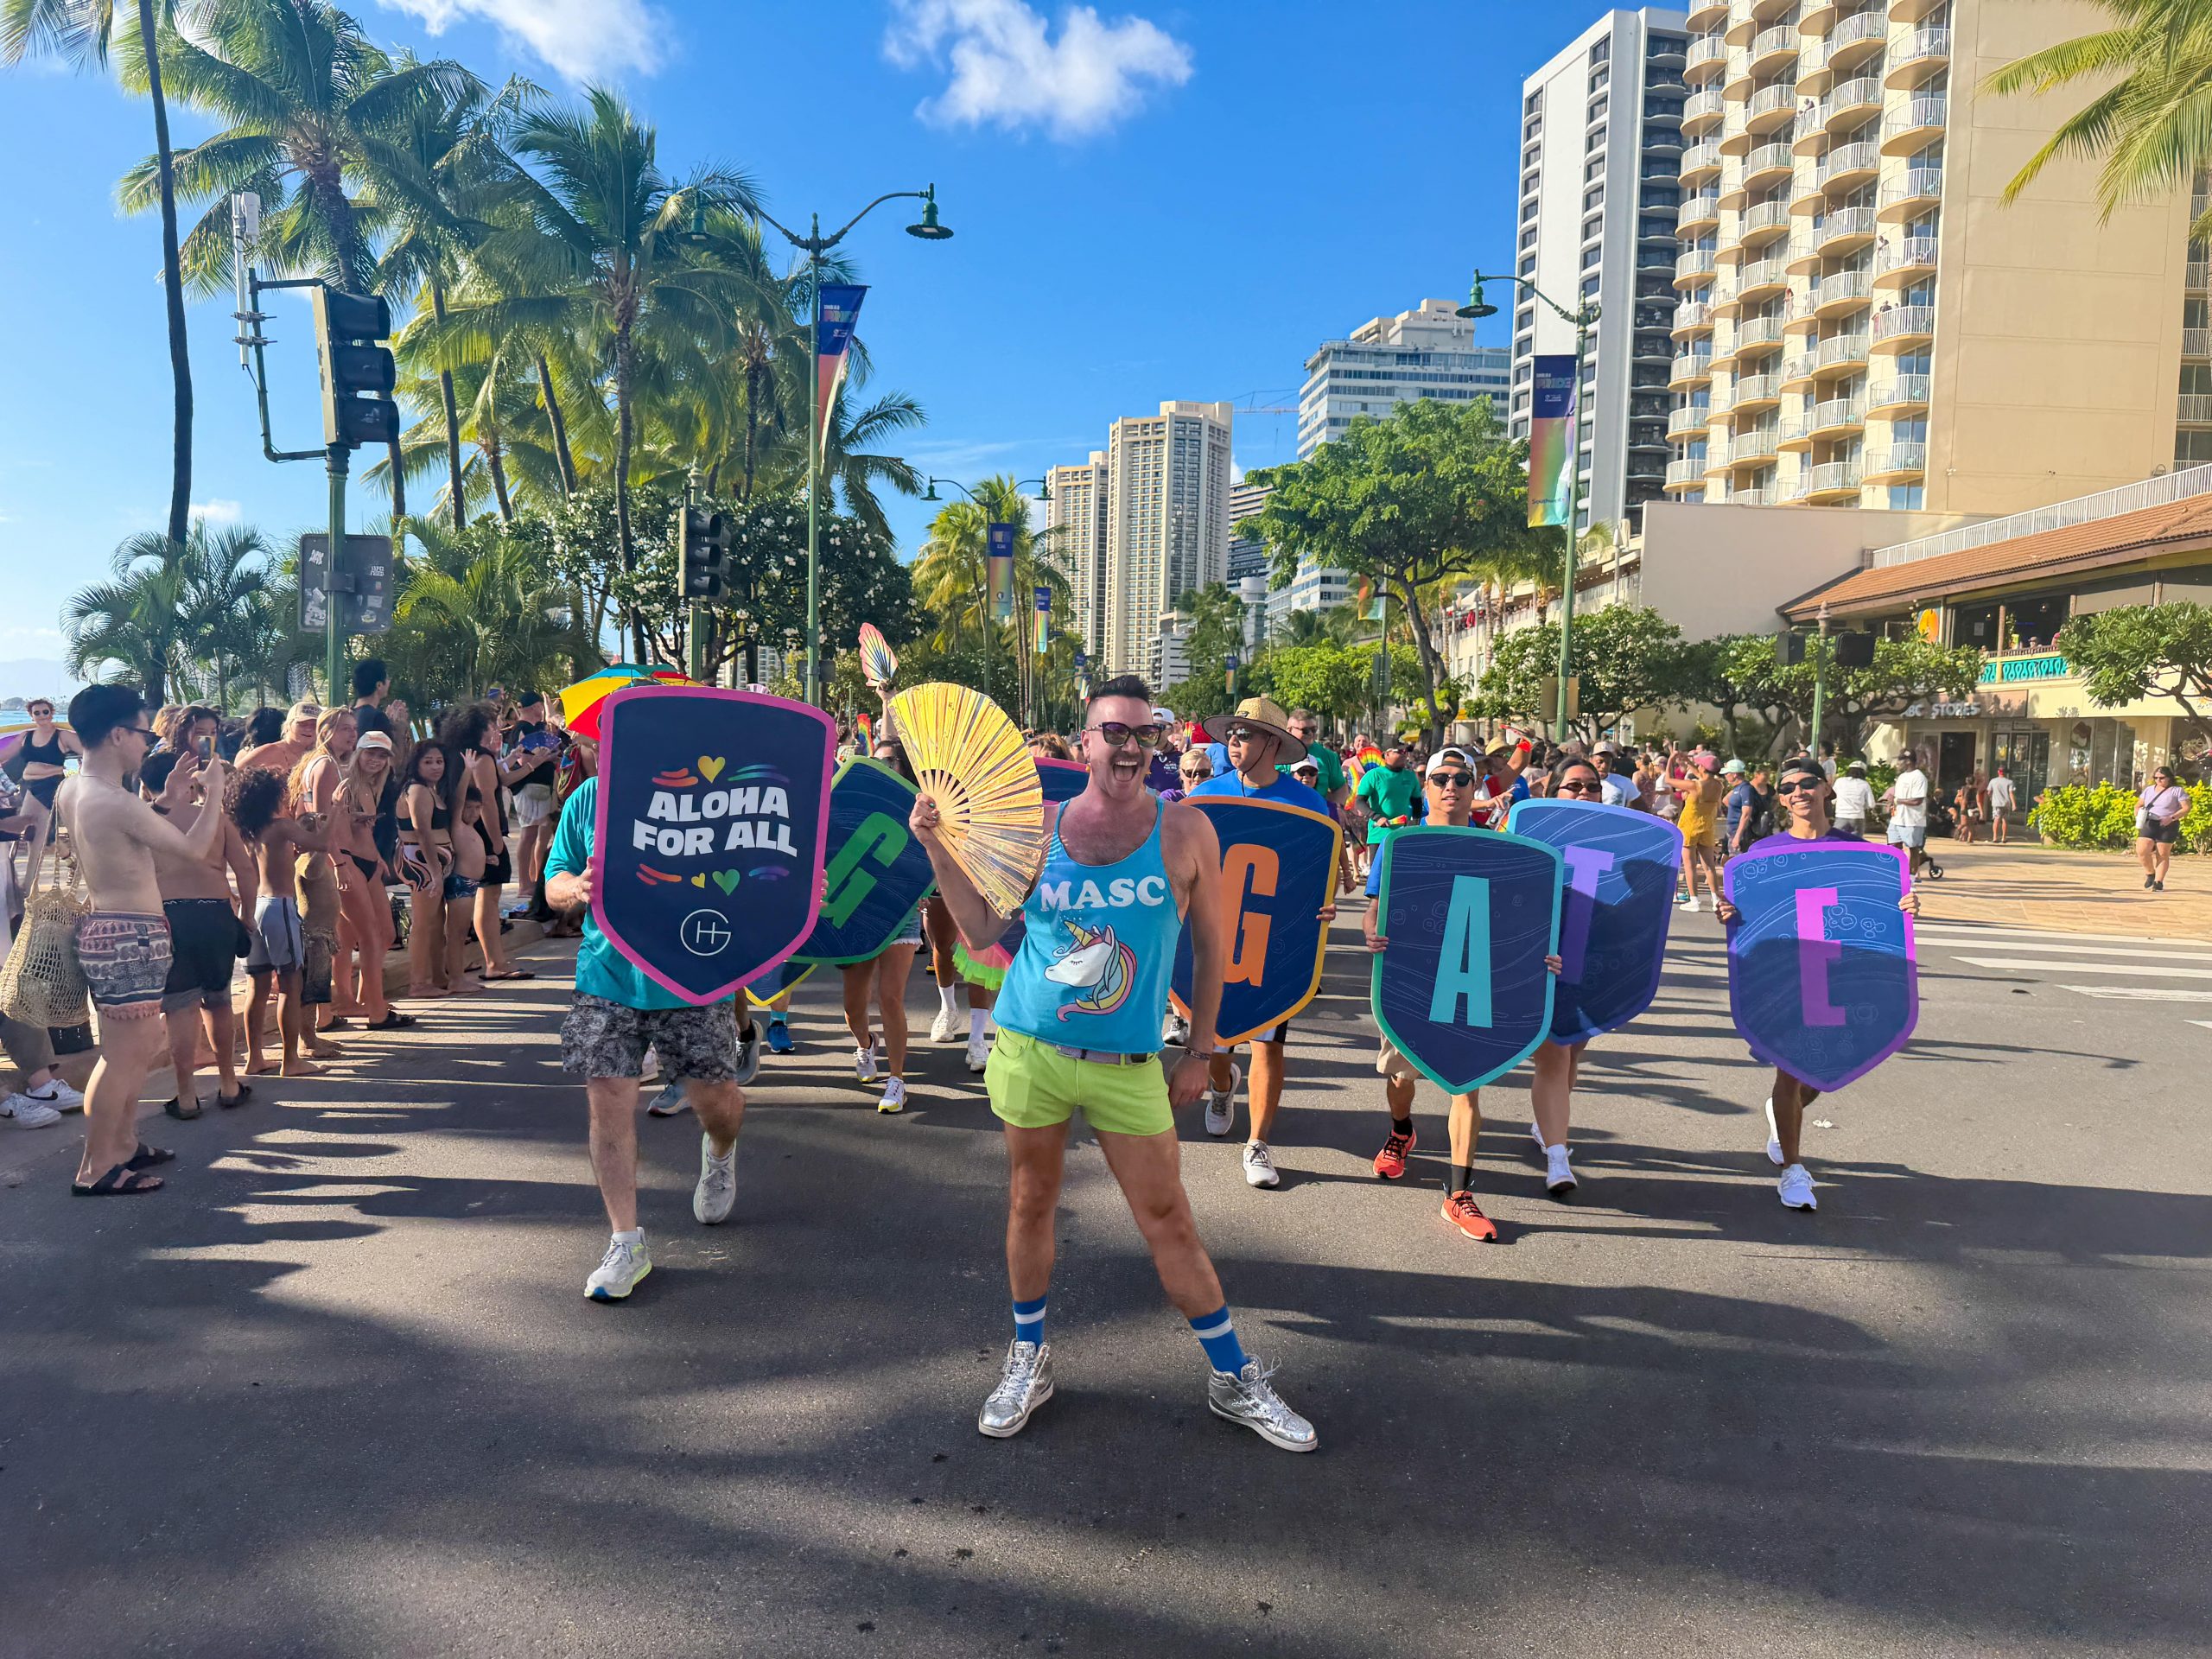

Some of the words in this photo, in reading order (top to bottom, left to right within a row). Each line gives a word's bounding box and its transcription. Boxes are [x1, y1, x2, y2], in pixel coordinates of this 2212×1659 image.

[1930, 702, 1981, 718] STORES
[632, 820, 715, 856] FOR
[725, 822, 798, 856] ALL
[647, 787, 789, 822] ALOHA
[823, 811, 908, 929] G
[1040, 875, 1165, 912] MASC
[1223, 843, 1280, 987] G
[1561, 846, 1614, 984] T
[1429, 874, 1493, 1027] A
[1796, 887, 1846, 1027] E
